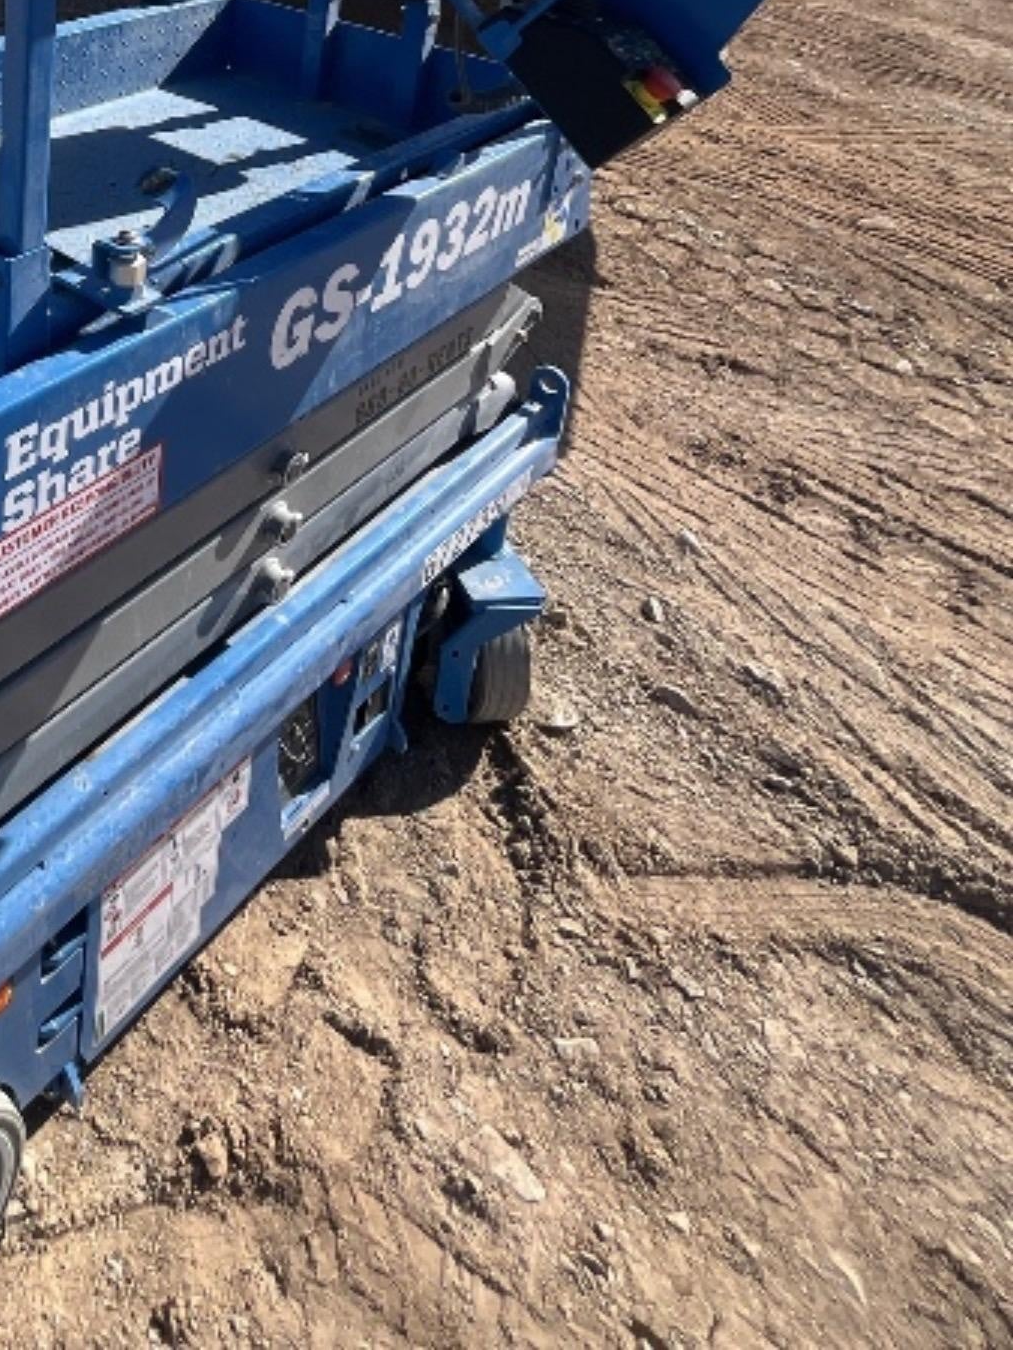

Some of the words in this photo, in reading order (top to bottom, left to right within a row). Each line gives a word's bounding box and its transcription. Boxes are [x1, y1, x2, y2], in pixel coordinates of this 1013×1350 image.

[270, 179, 532, 370] GS-1932m
[1, 427, 142, 532] Share
[4, 313, 247, 481] Equipment
